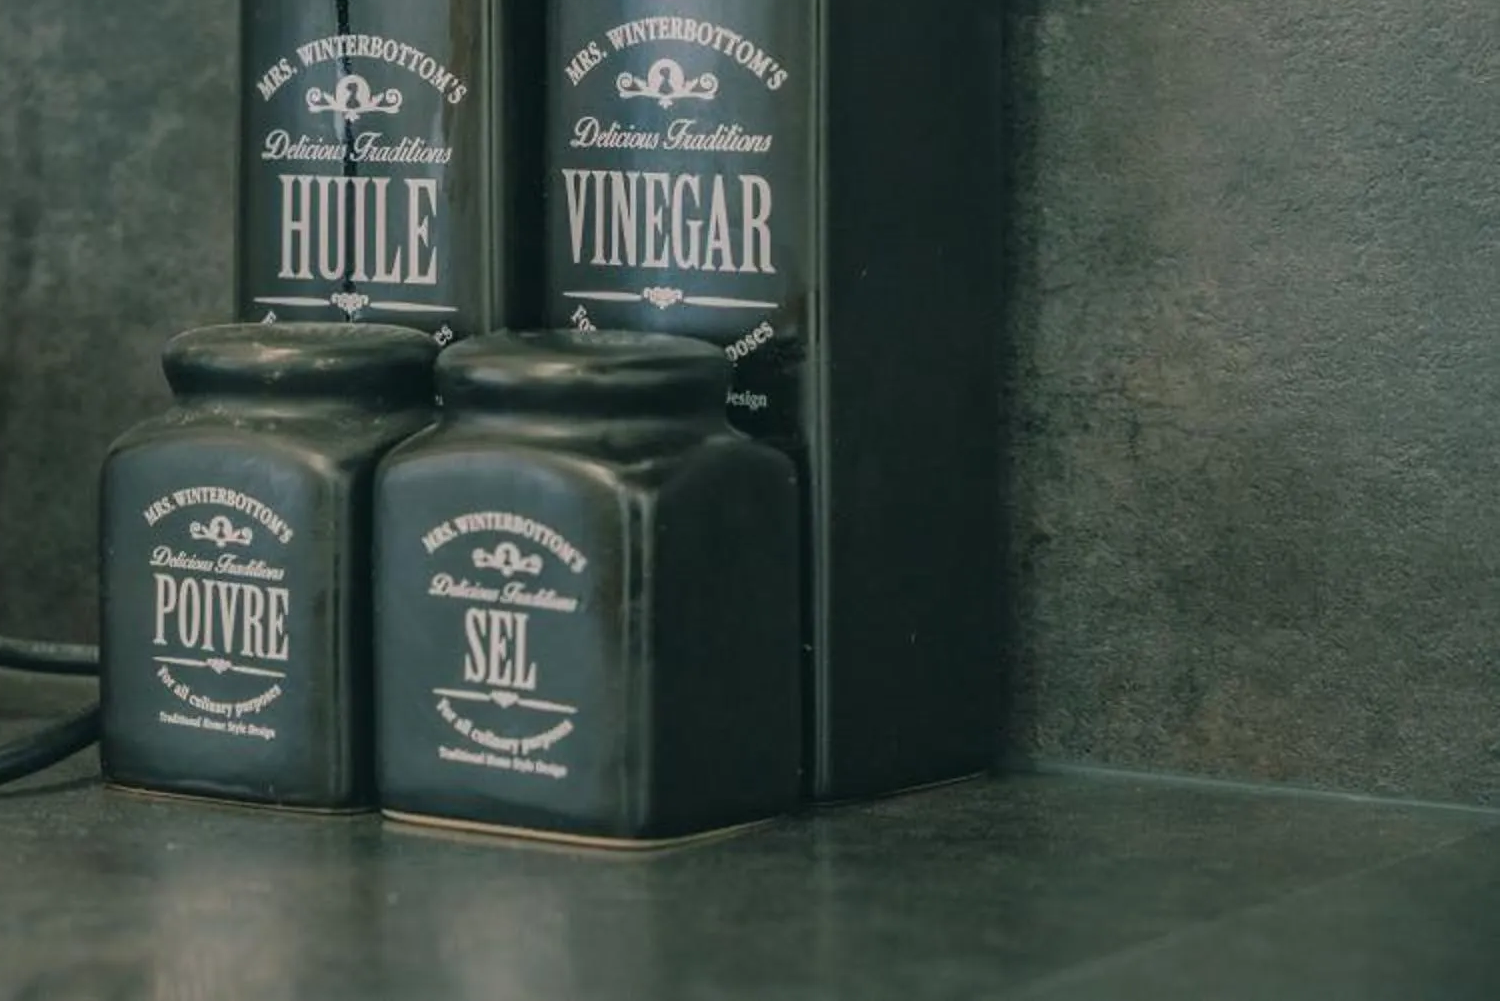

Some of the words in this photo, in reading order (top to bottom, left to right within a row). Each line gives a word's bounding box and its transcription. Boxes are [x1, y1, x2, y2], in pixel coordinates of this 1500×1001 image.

[256, 58, 298, 101] MRS.
[297, 34, 468, 103] WINTERBOTTOM'S
[565, 42, 607, 86] MRS.
[605, 17, 788, 90] WINTERBOTTOM'S
[261, 129, 347, 160] Delicious
[350, 132, 453, 164] Traditions
[570, 116, 660, 149] Delicious
[663, 118, 772, 152] Traditions
[278, 174, 438, 285] HUILE
[562, 169, 777, 274] VINEGAR
[143, 497, 176, 527] MRS.
[172, 486, 293, 544] WINTERBOTTOM'S
[149, 545, 214, 572] Delicious
[153, 573, 289, 661] POIVRE
[465, 607, 536, 691] SEL
